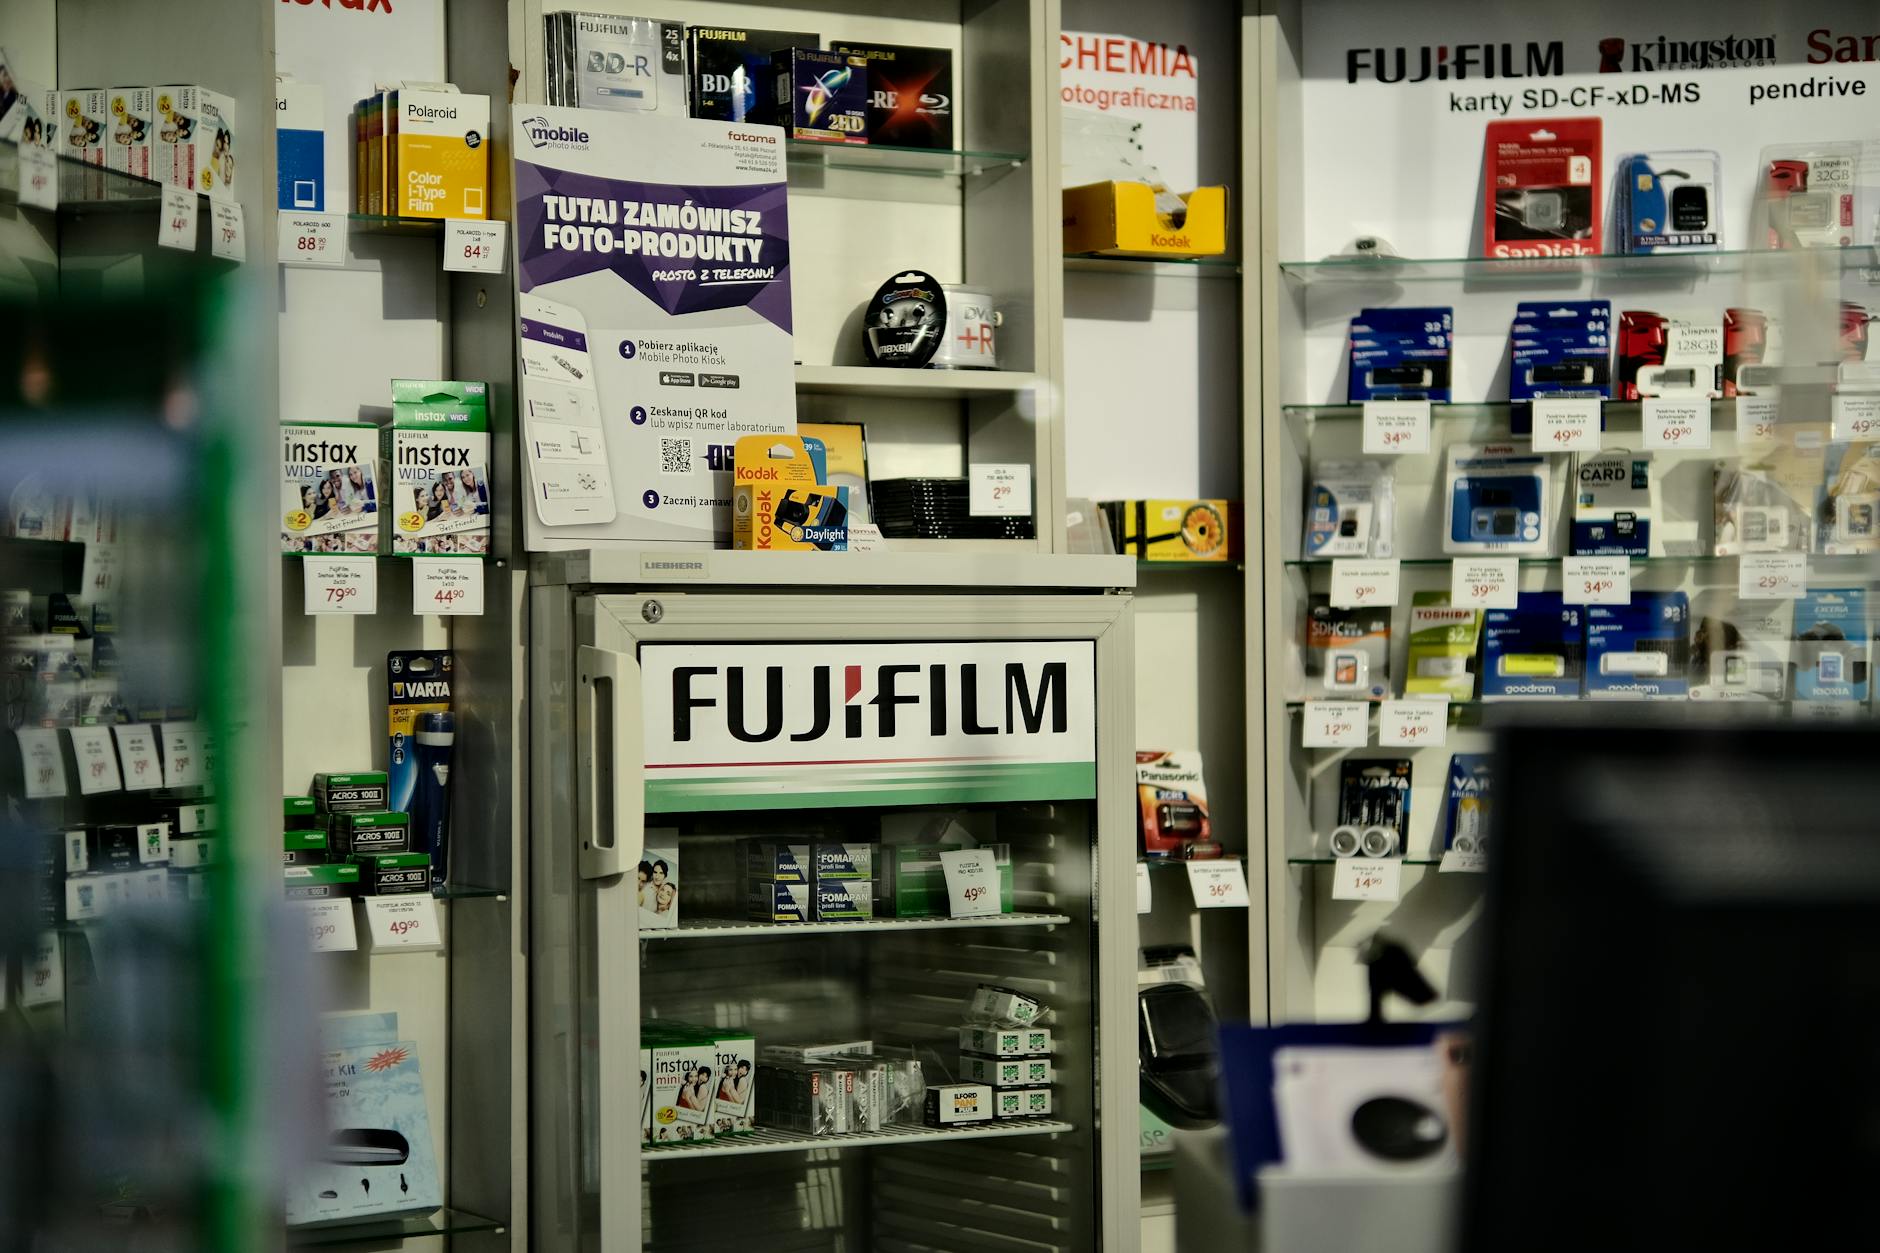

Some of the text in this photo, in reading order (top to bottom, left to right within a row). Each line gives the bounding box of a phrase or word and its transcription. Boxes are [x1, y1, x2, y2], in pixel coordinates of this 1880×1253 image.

[580, 22, 628, 35] FUJIFILM
[666, 30, 678, 39] 25
[700, 29, 746, 41] FUJIFILM
[666, 52, 678, 61] 4x
[807, 53, 841, 64] FUJIFILM
[1060, 34, 1196, 79] CHEMIA
[1631, 34, 1773, 72] Kingston
[587, 51, 651, 77] BD-R
[1347, 42, 1563, 84] FUJIFILM
[1657, 58, 1777, 70] TECHNOLOGY
[1750, 76, 1866, 104] pendrive
[1062, 85, 1196, 112] otograficzna
[1450, 82, 1700, 115] karty SD-CF-xD-MS
[408, 104, 457, 119] Polaroid
[828, 114, 865, 132] 2HD
[532, 126, 589, 143] mobile
[728, 131, 776, 144] fotoma
[548, 140, 590, 151] photo kiosk
[408, 171, 442, 184] Color
[1815, 169, 1849, 182] 32GB
[408, 184, 446, 200] i-Type
[408, 198, 433, 212] Film
[543, 195, 762, 235] TUTAJ ZAMÓWISZ
[298, 236, 316, 250] 88
[544, 224, 763, 263] FOTO-PRODUKTY
[1151, 234, 1190, 248] Kodak
[464, 245, 480, 258] 84
[652, 266, 774, 281] PROSTO Z TELEFONU!
[958, 324, 993, 354] +R
[1677, 339, 1718, 351] 128GB
[638, 340, 718, 355] Pobierz aplikację
[879, 343, 912, 353] maxell
[639, 352, 726, 365] Mobile Photo Kiosk
[415, 410, 446, 422] instax
[650, 406, 727, 419] Zeskanuj QR kod
[651, 419, 785, 432] lub wpisz numer laboratorium
[1553, 430, 1582, 442] 4990
[1663, 427, 1691, 441] 6990
[284, 436, 357, 464] instax
[398, 440, 470, 466] instax
[286, 465, 322, 478] WIDE
[400, 468, 436, 480] WIDE
[737, 466, 778, 481] Kodak
[1581, 468, 1625, 480] CARD
[994, 487, 1011, 499] 299
[663, 496, 734, 508] Zacznij zamaw
[326, 515, 366, 531] Best Friends!
[439, 515, 478, 532] Best Friends!
[757, 489, 771, 549] Kodak
[805, 528, 844, 541] Daylight
[1584, 580, 1613, 593] 3490
[1759, 576, 1788, 588] 2990
[326, 588, 357, 602] 7990
[435, 590, 464, 604] 4490
[1356, 586, 1376, 600] 990
[1472, 585, 1500, 597] 3990
[1416, 610, 1471, 620] TOSHIBA
[1312, 622, 1343, 637] SDHC
[1448, 627, 1465, 642] 32
[406, 682, 450, 697] VARTA
[1505, 684, 1556, 695] goodram
[1812, 688, 1849, 696] KIOXIA
[673, 662, 1066, 742] FUJIFILM
[1325, 724, 1351, 736] 1290
[1400, 727, 1428, 738] 3490
[1141, 771, 1199, 781] Panasonic
[1360, 777, 1409, 789] VARTA
[1454, 776, 1490, 790] VAR
[332, 791, 358, 800] ACROS
[356, 832, 382, 841] ACROS
[821, 854, 868, 864] FOMAPAN
[381, 874, 405, 882] ACROS
[1355, 878, 1382, 888] 1490
[821, 893, 868, 902] FOMAPAN
[964, 887, 986, 901] 4990
[390, 921, 419, 934] 4990
[715, 1052, 738, 1065] tax
[338, 1064, 356, 1076] Kit
[656, 1058, 698, 1074] instax
[656, 1075, 680, 1085] mini
